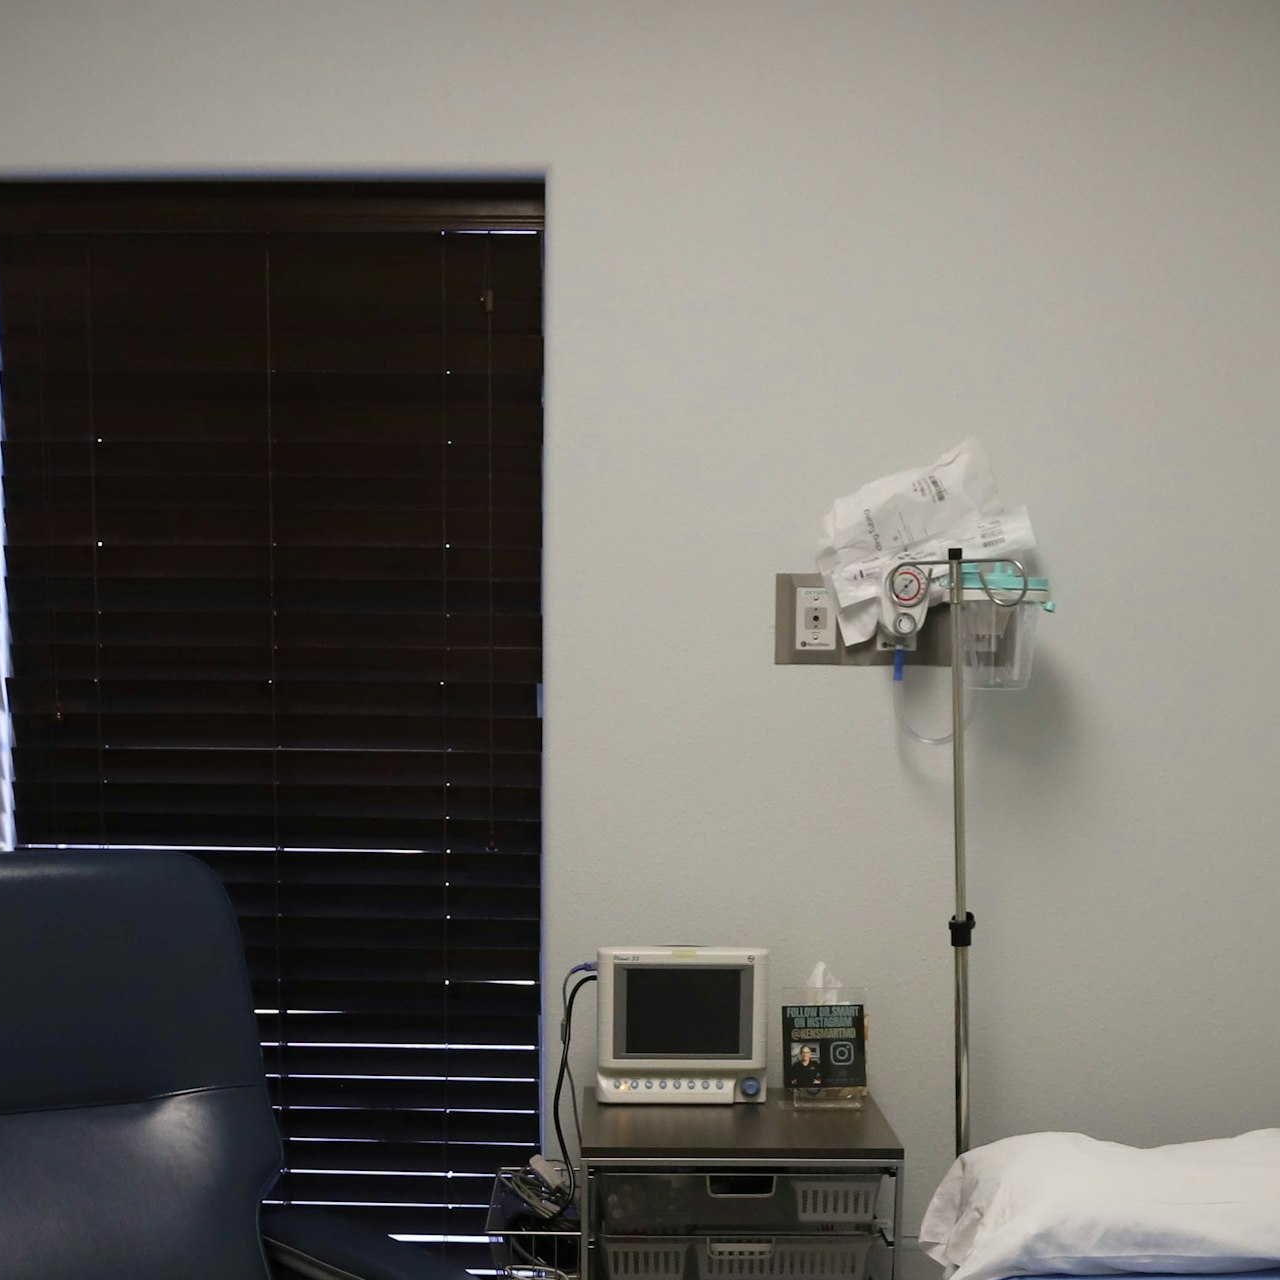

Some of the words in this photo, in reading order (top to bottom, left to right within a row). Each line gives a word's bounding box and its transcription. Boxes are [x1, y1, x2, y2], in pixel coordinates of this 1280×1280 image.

[786, 1007, 818, 1018] FOLLOW
[794, 1017, 806, 1028] ON
[806, 1016, 853, 1027] INSTAGRAM
